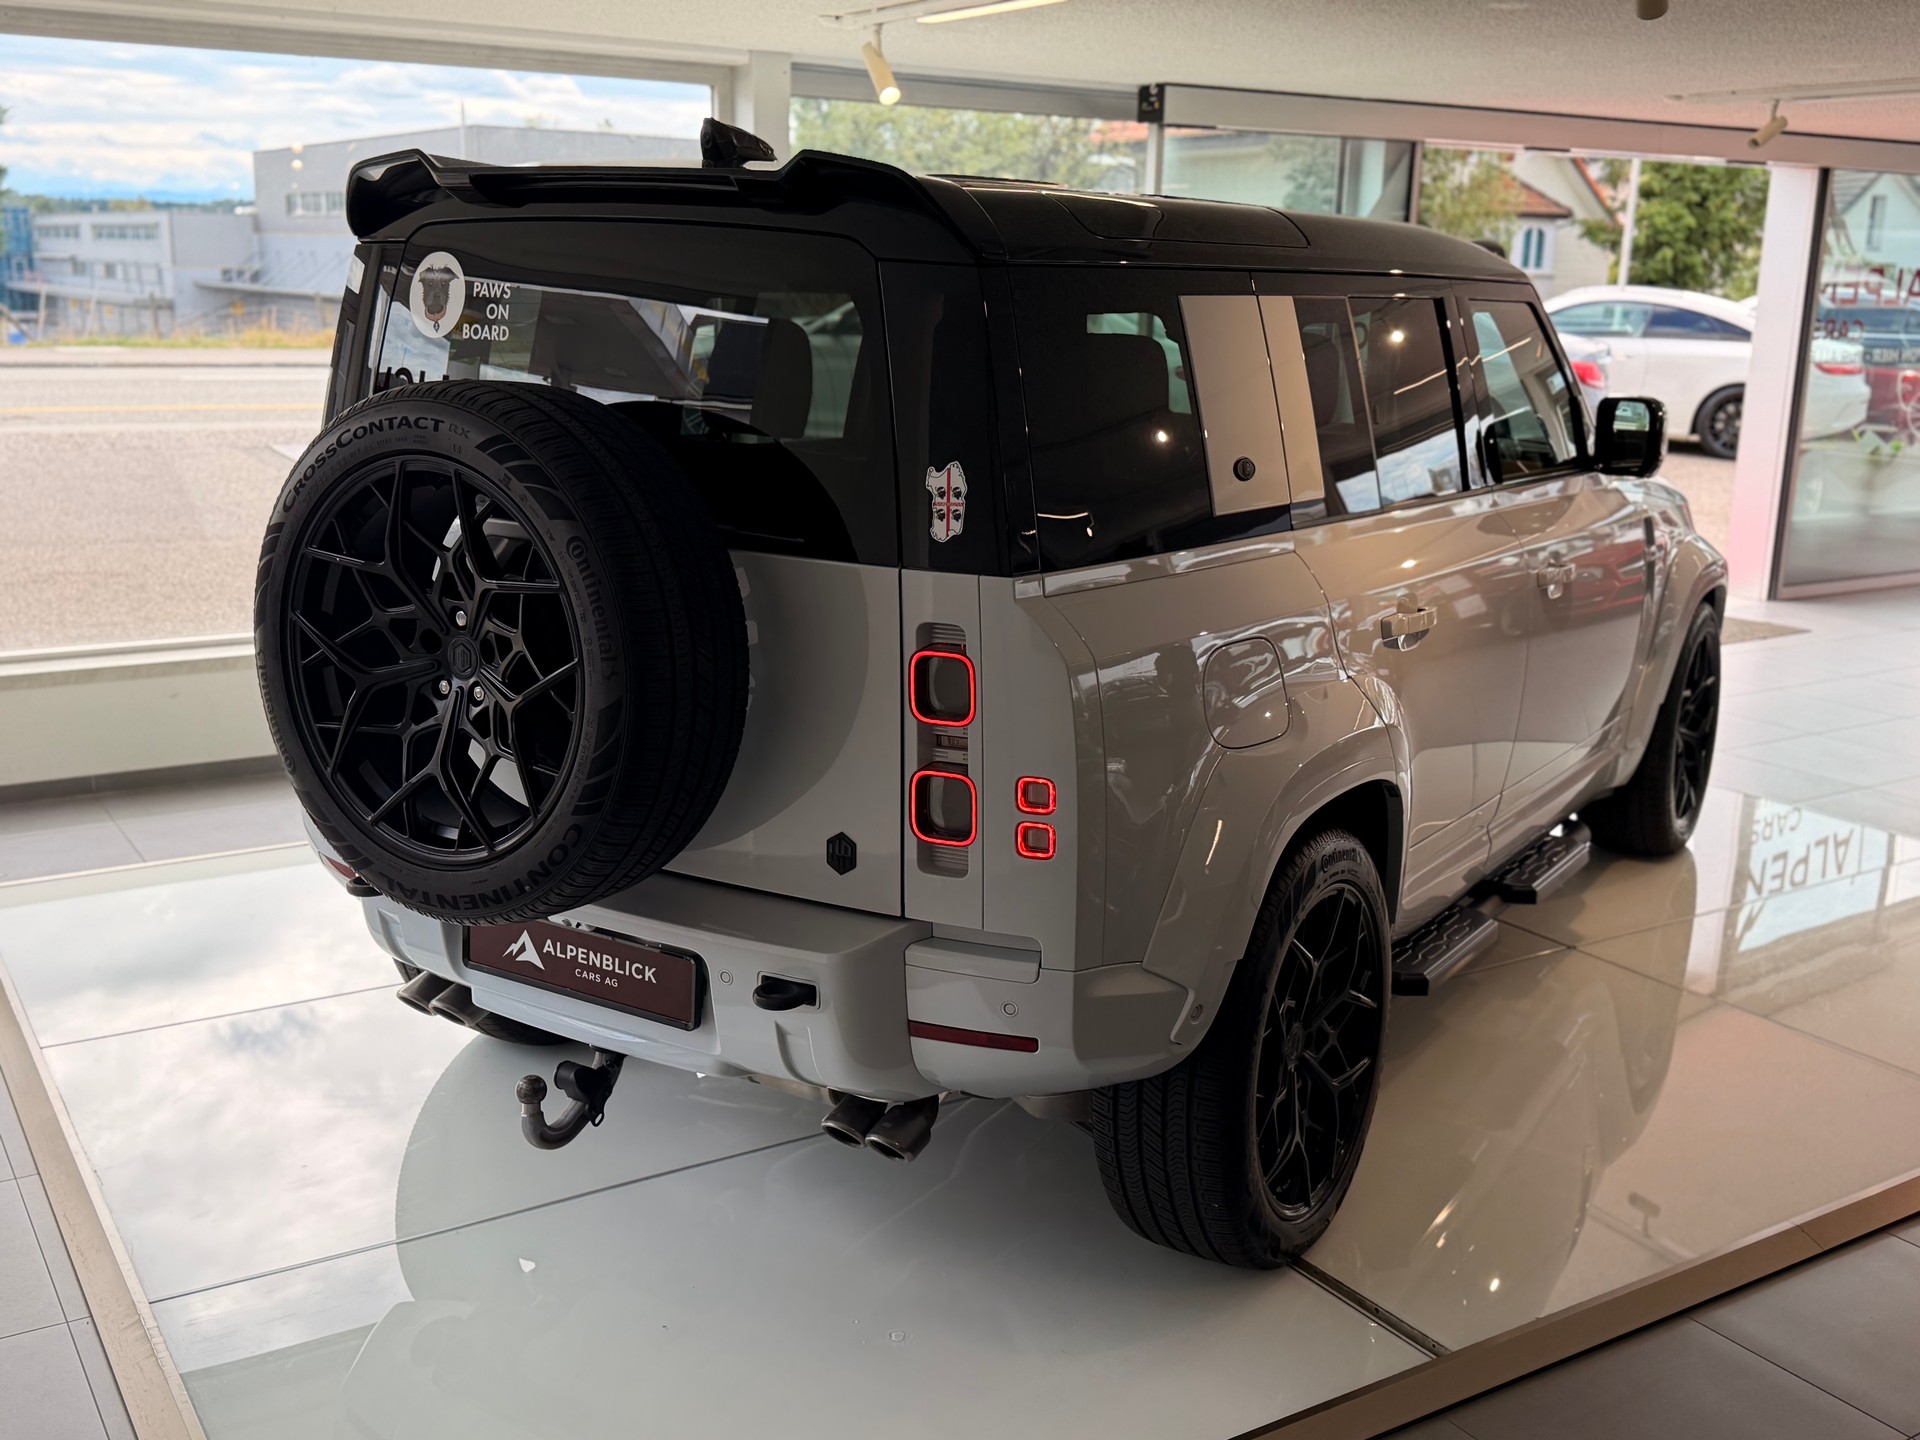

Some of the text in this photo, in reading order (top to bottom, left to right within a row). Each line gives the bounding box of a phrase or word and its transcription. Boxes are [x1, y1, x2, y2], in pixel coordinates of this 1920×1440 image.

[473, 282, 511, 299] PAWS
[486, 303, 509, 320] ON
[462, 323, 509, 341] BOARD
[448, 422, 472, 440] RX
[565, 535, 617, 664] Continental
[379, 823, 583, 911] CONTINENTAL
[542, 938, 657, 984] ALPENBLICK
[575, 968, 618, 988] CARS AG
